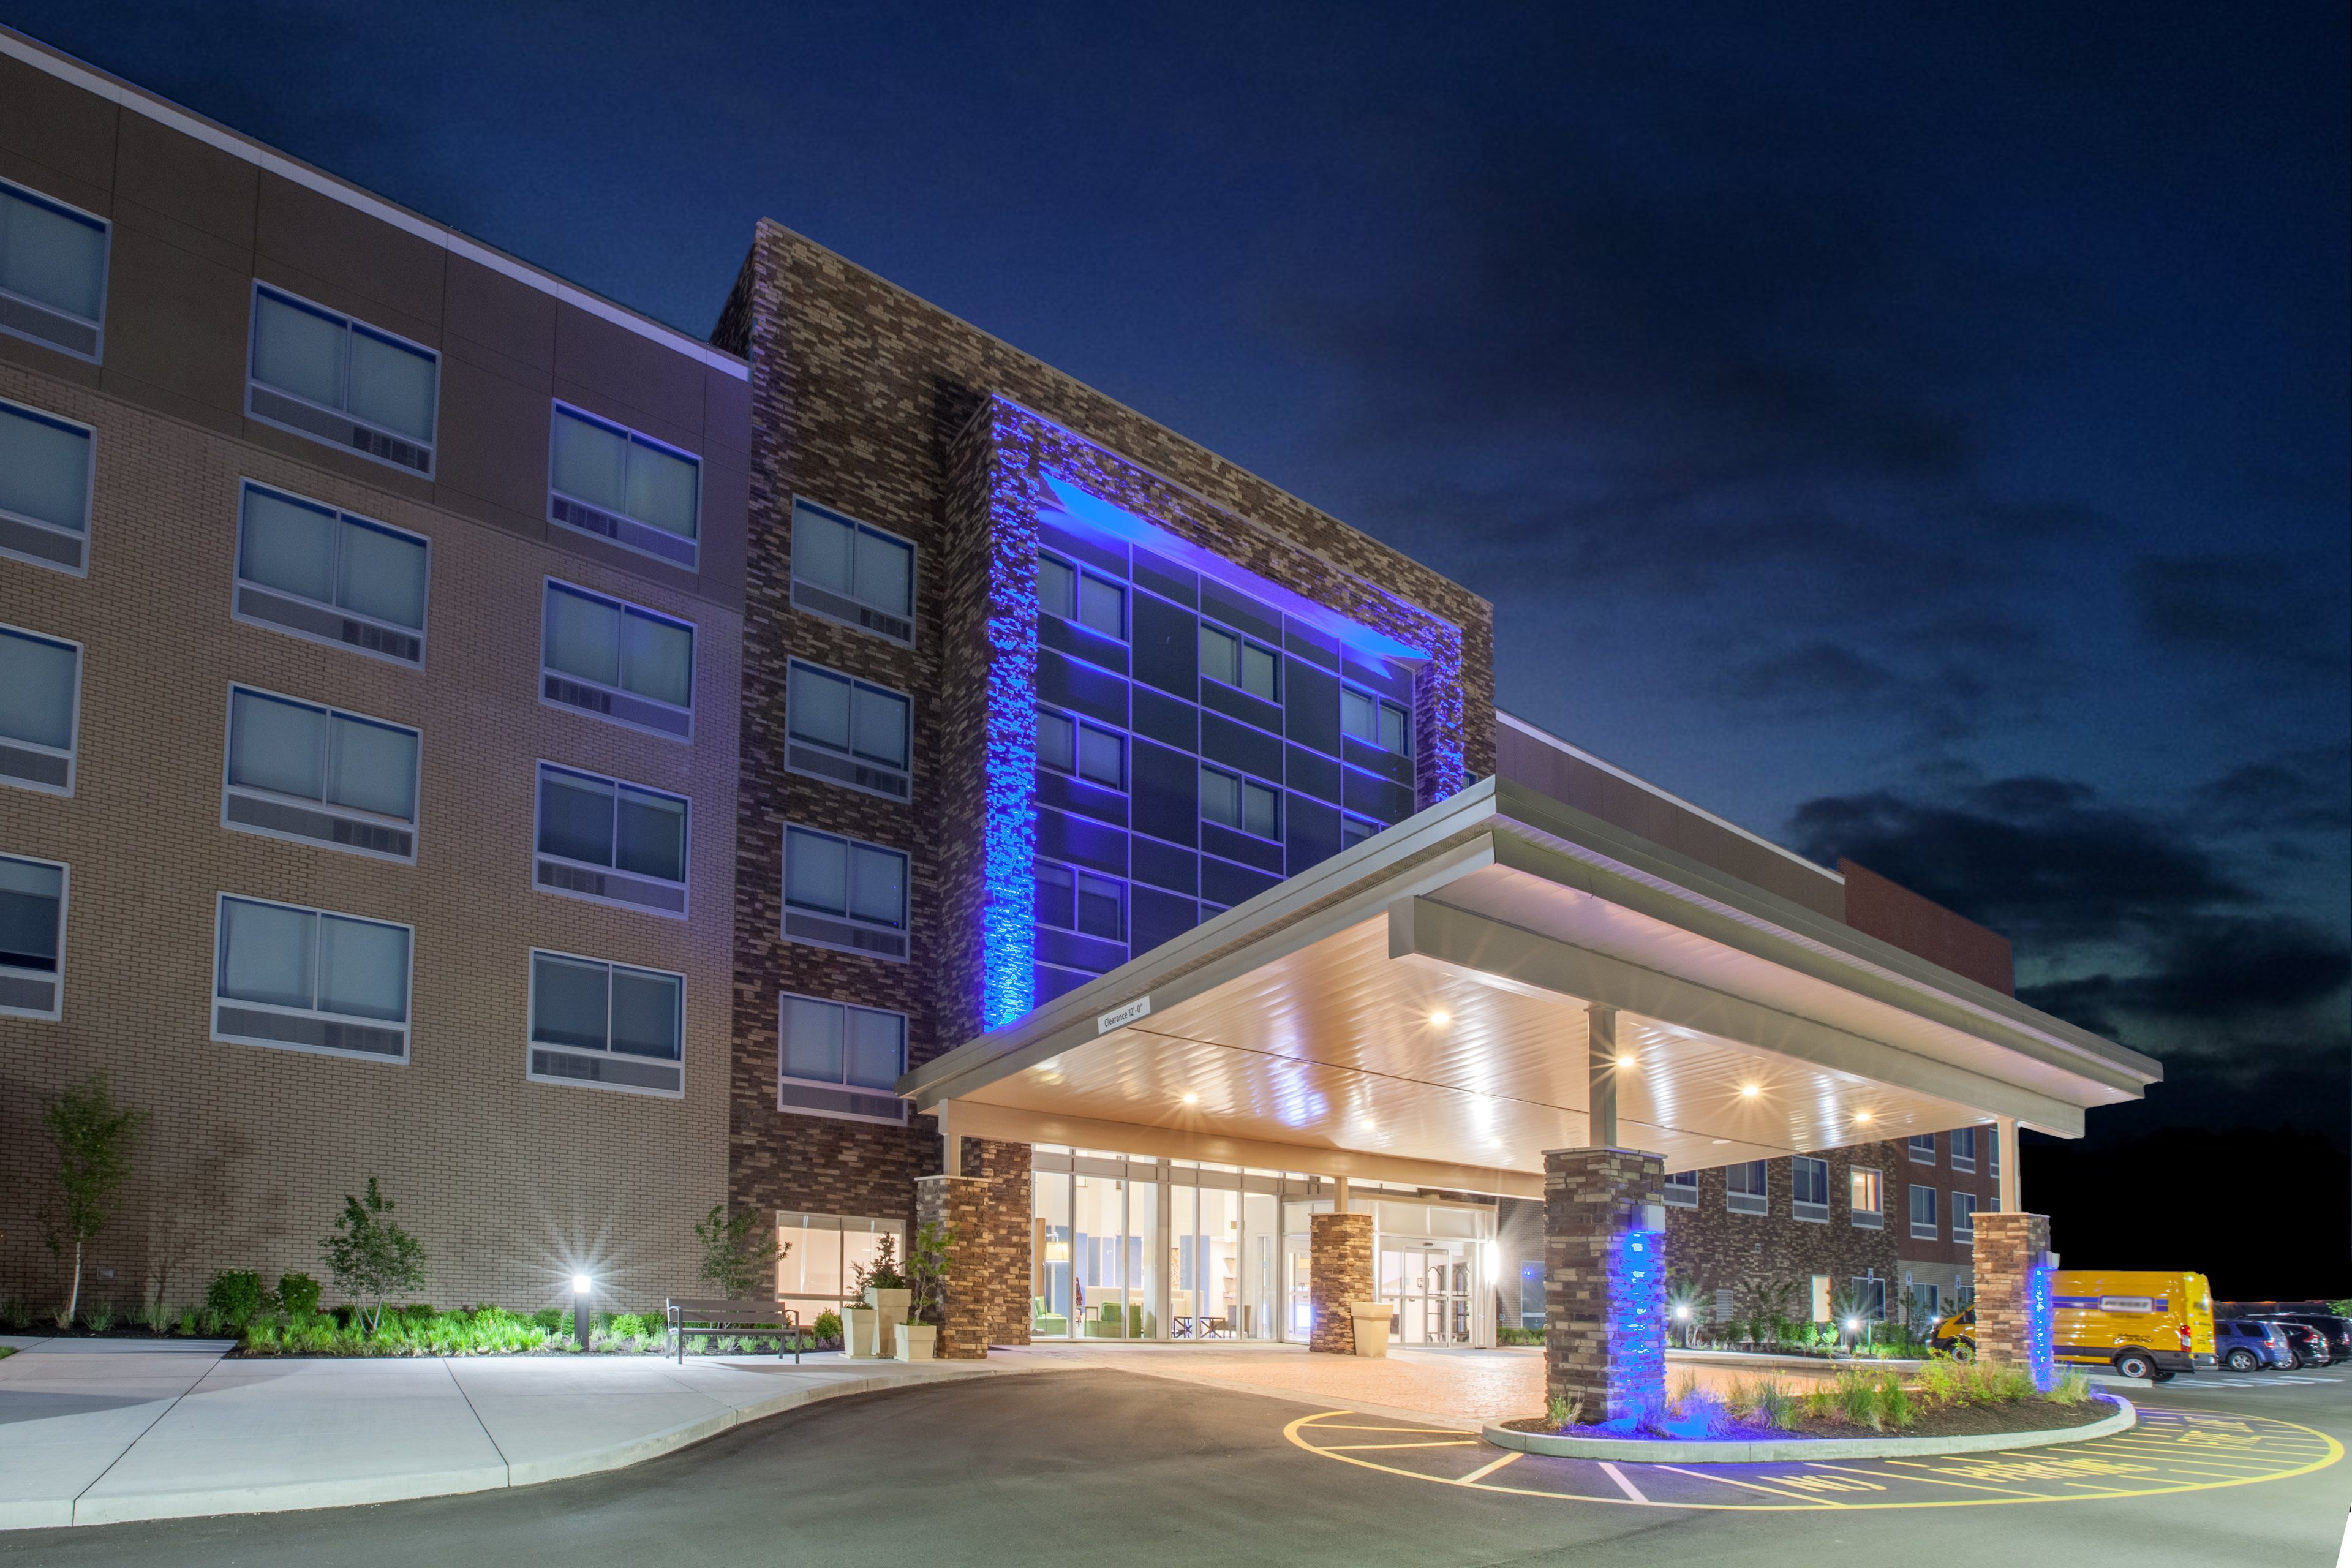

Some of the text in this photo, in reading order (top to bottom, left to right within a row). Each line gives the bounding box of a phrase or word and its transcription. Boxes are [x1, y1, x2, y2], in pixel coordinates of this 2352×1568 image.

[1104, 1012, 1128, 1027] Clearance
[1756, 1474, 1888, 1492] NO
[1927, 1458, 2159, 1483] PARKING
